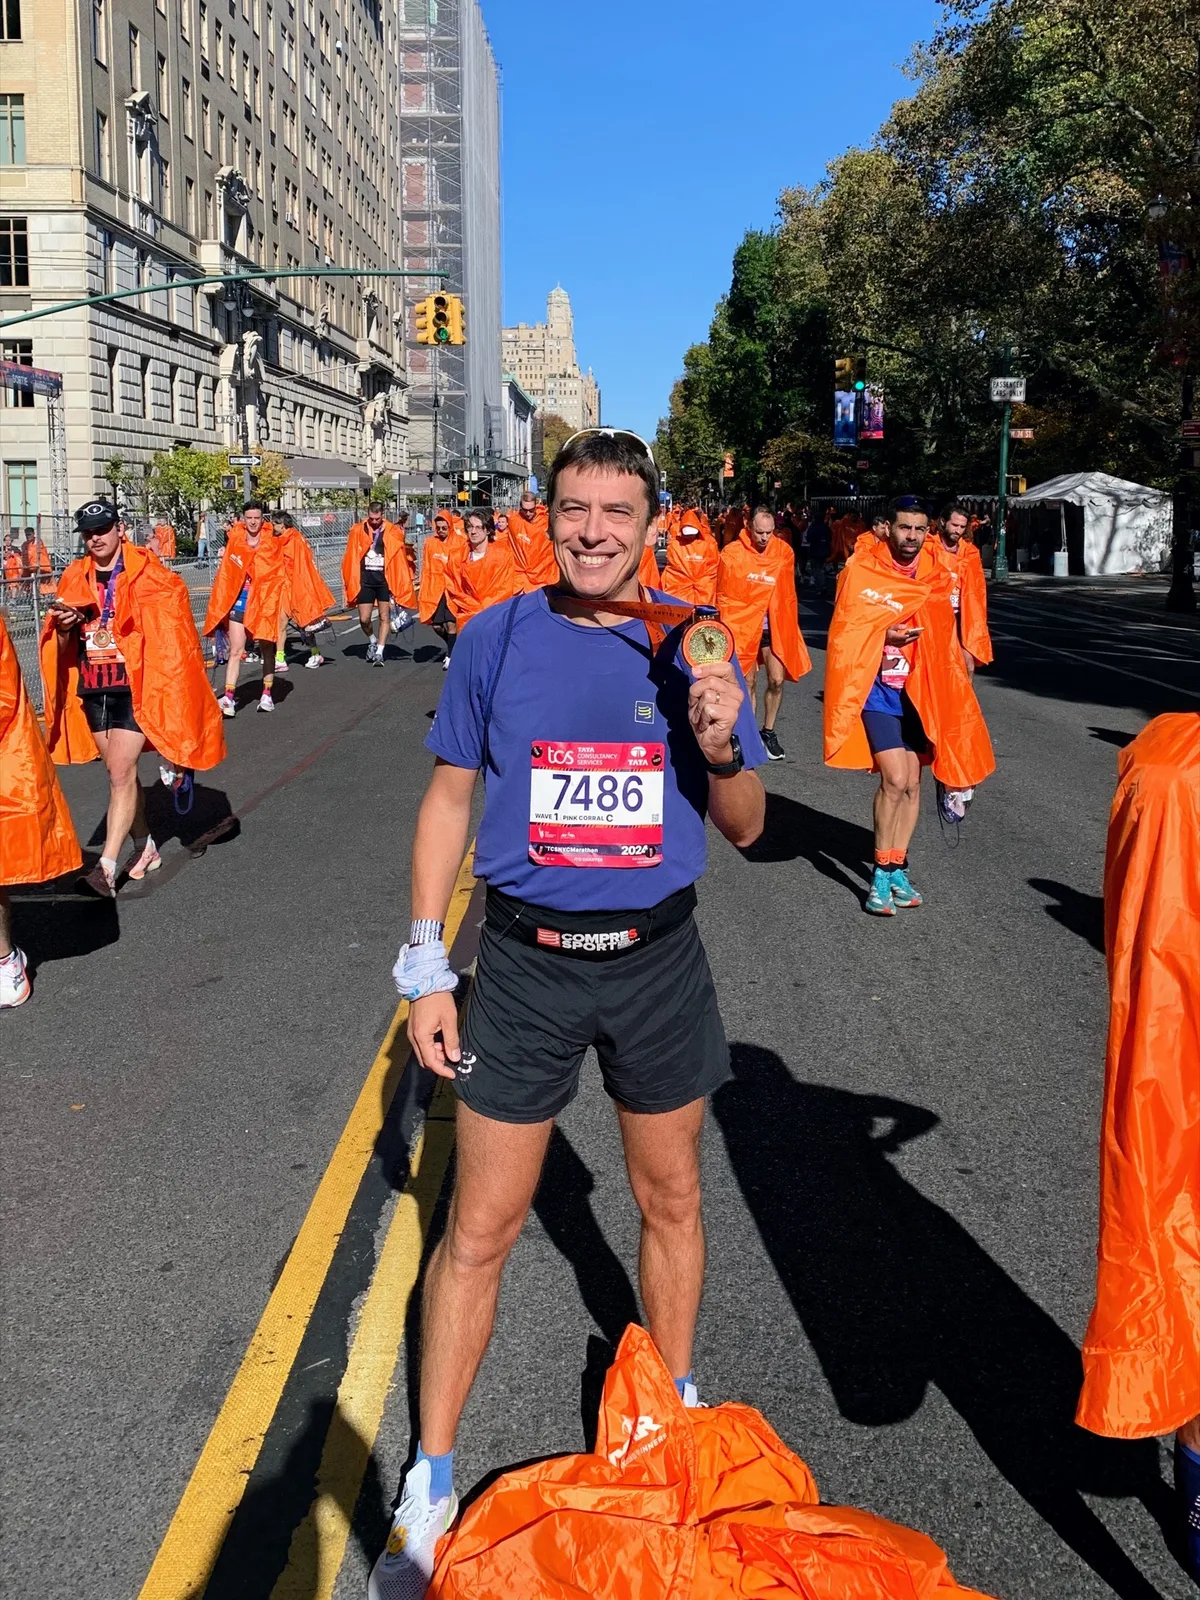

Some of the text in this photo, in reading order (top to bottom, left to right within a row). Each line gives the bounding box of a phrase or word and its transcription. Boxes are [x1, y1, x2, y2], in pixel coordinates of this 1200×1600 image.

[992, 380, 1024, 389] PASSENGER
[992, 389, 1023, 397] CARS ONLY
[81, 661, 130, 689] WIL
[552, 774, 643, 812] 7486
[554, 812, 559, 821] 1
[606, 814, 614, 823] C
